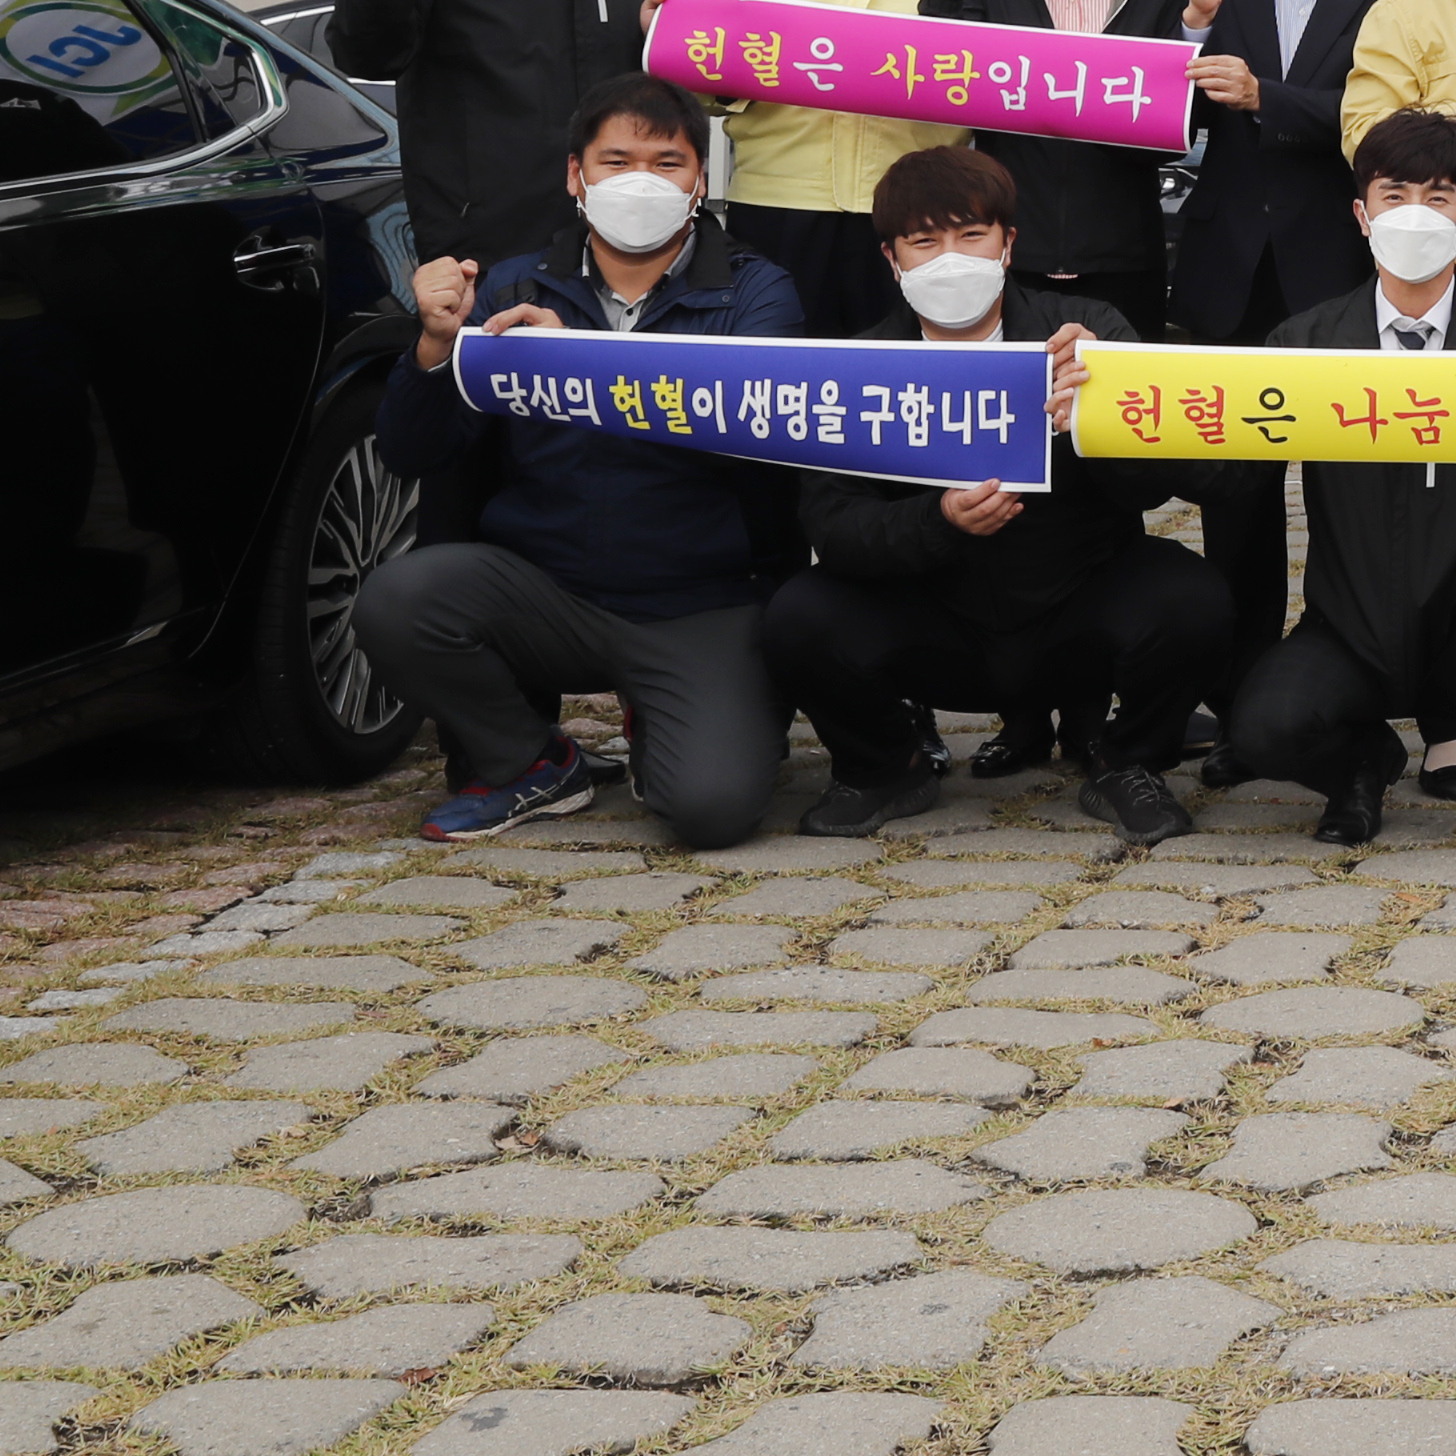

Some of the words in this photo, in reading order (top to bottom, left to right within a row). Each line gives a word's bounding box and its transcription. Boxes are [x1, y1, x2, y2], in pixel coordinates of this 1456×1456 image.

[684, 25, 844, 89] 헌혈은
[871, 44, 1152, 124] 사랑입니다
[490, 372, 601, 425] 당신의
[608, 374, 727, 434] 헌혈이
[737, 378, 847, 445] 생명을
[859, 382, 1016, 447] 구합니다
[1116, 384, 1297, 445] 헌혈은
